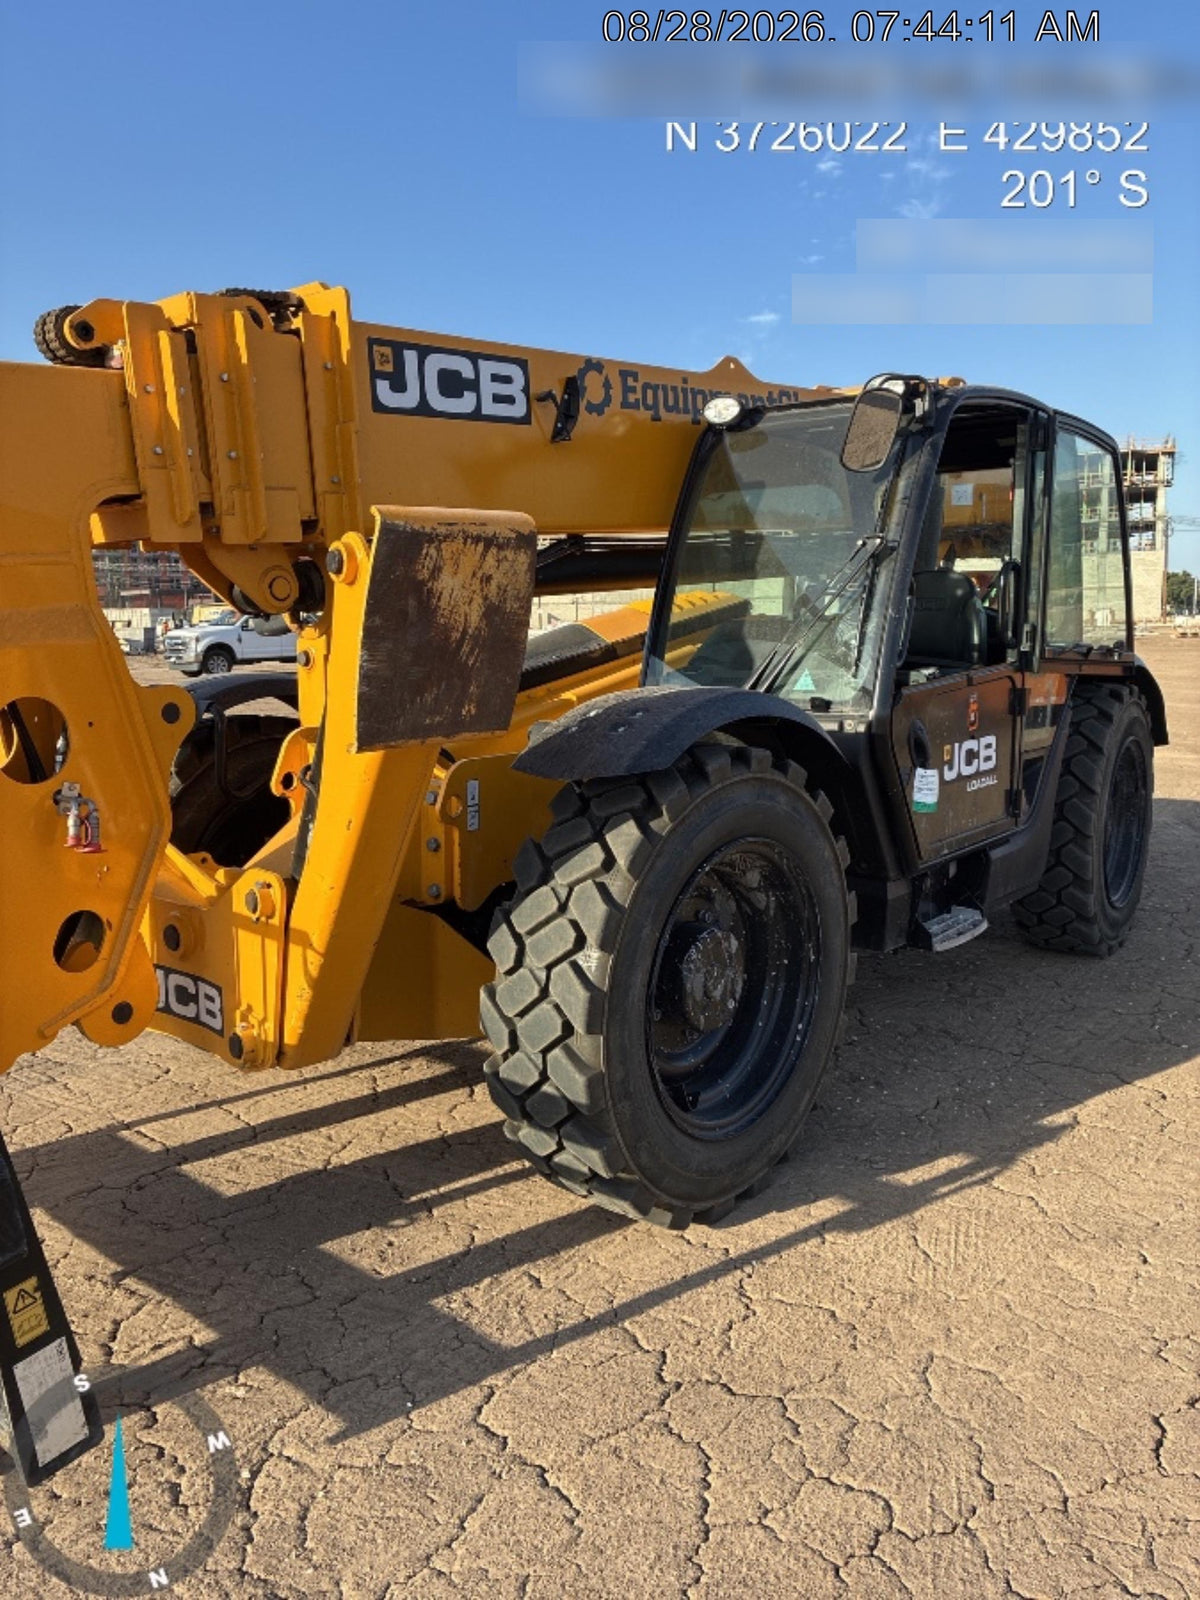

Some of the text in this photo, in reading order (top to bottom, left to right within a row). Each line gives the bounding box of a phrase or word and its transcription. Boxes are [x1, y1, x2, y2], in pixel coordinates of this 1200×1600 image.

[376, 349, 527, 418] JCB
[943, 735, 997, 781] JCB
[966, 775, 998, 792] LOADALL
